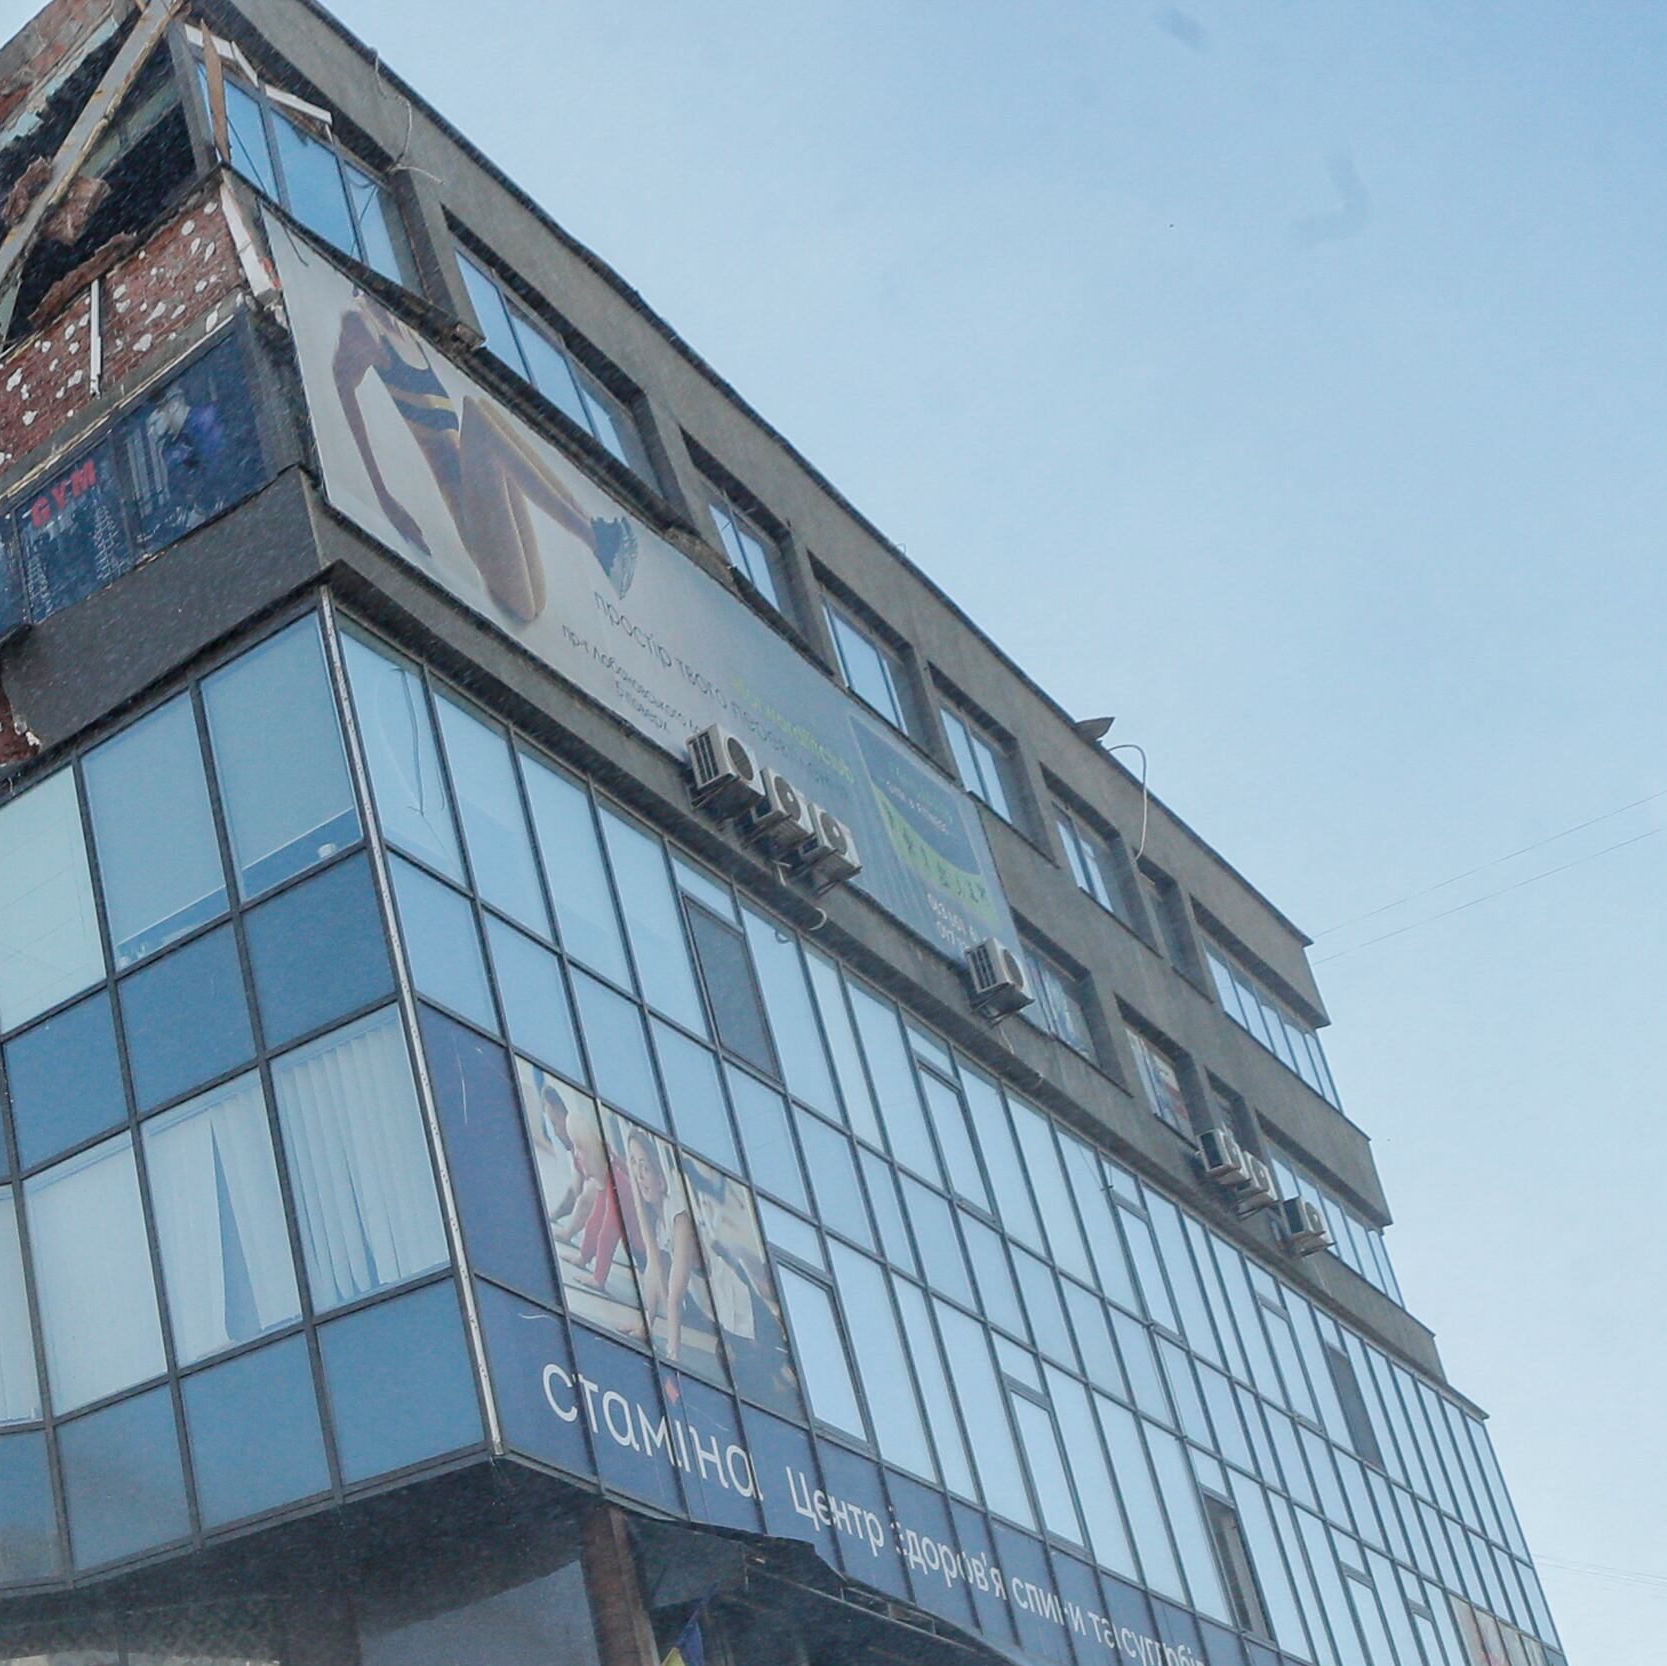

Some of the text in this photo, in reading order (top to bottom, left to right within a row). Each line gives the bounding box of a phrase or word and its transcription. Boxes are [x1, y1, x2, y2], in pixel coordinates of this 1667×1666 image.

[33, 457, 97, 527] GYM
[785, 1466, 884, 1556] Центр
[1012, 1578, 1085, 1634] спини
